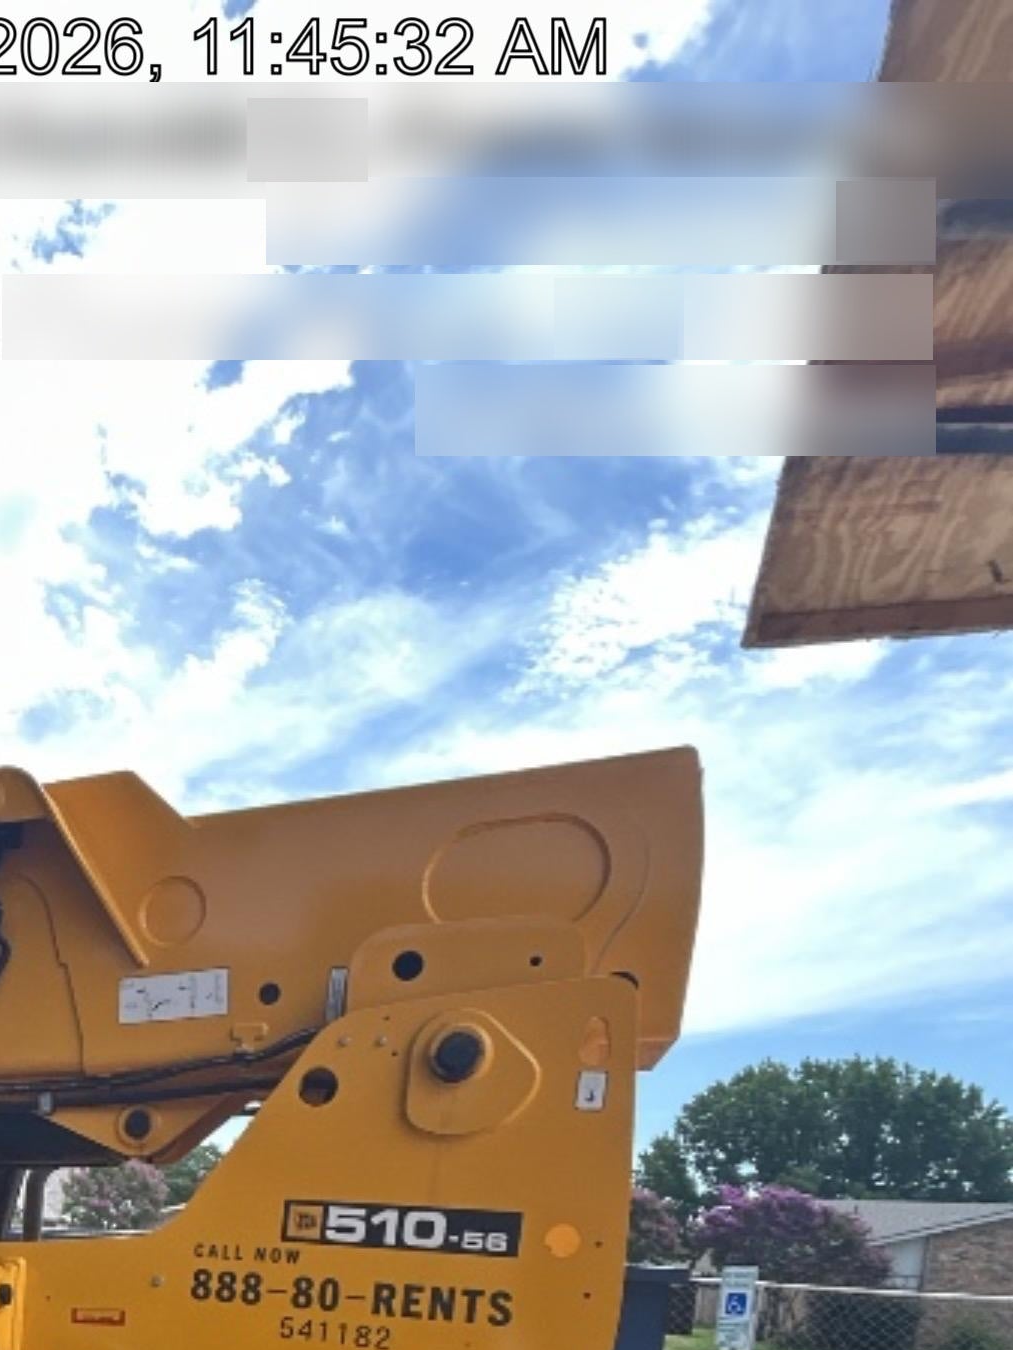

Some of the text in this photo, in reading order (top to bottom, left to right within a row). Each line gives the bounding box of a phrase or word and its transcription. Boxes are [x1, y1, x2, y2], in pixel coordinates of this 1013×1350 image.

[193, 1243, 300, 1264] CALL NOW
[190, 1268, 514, 1327] 888-80-RENTS
[279, 1316, 390, 1350] 541182
